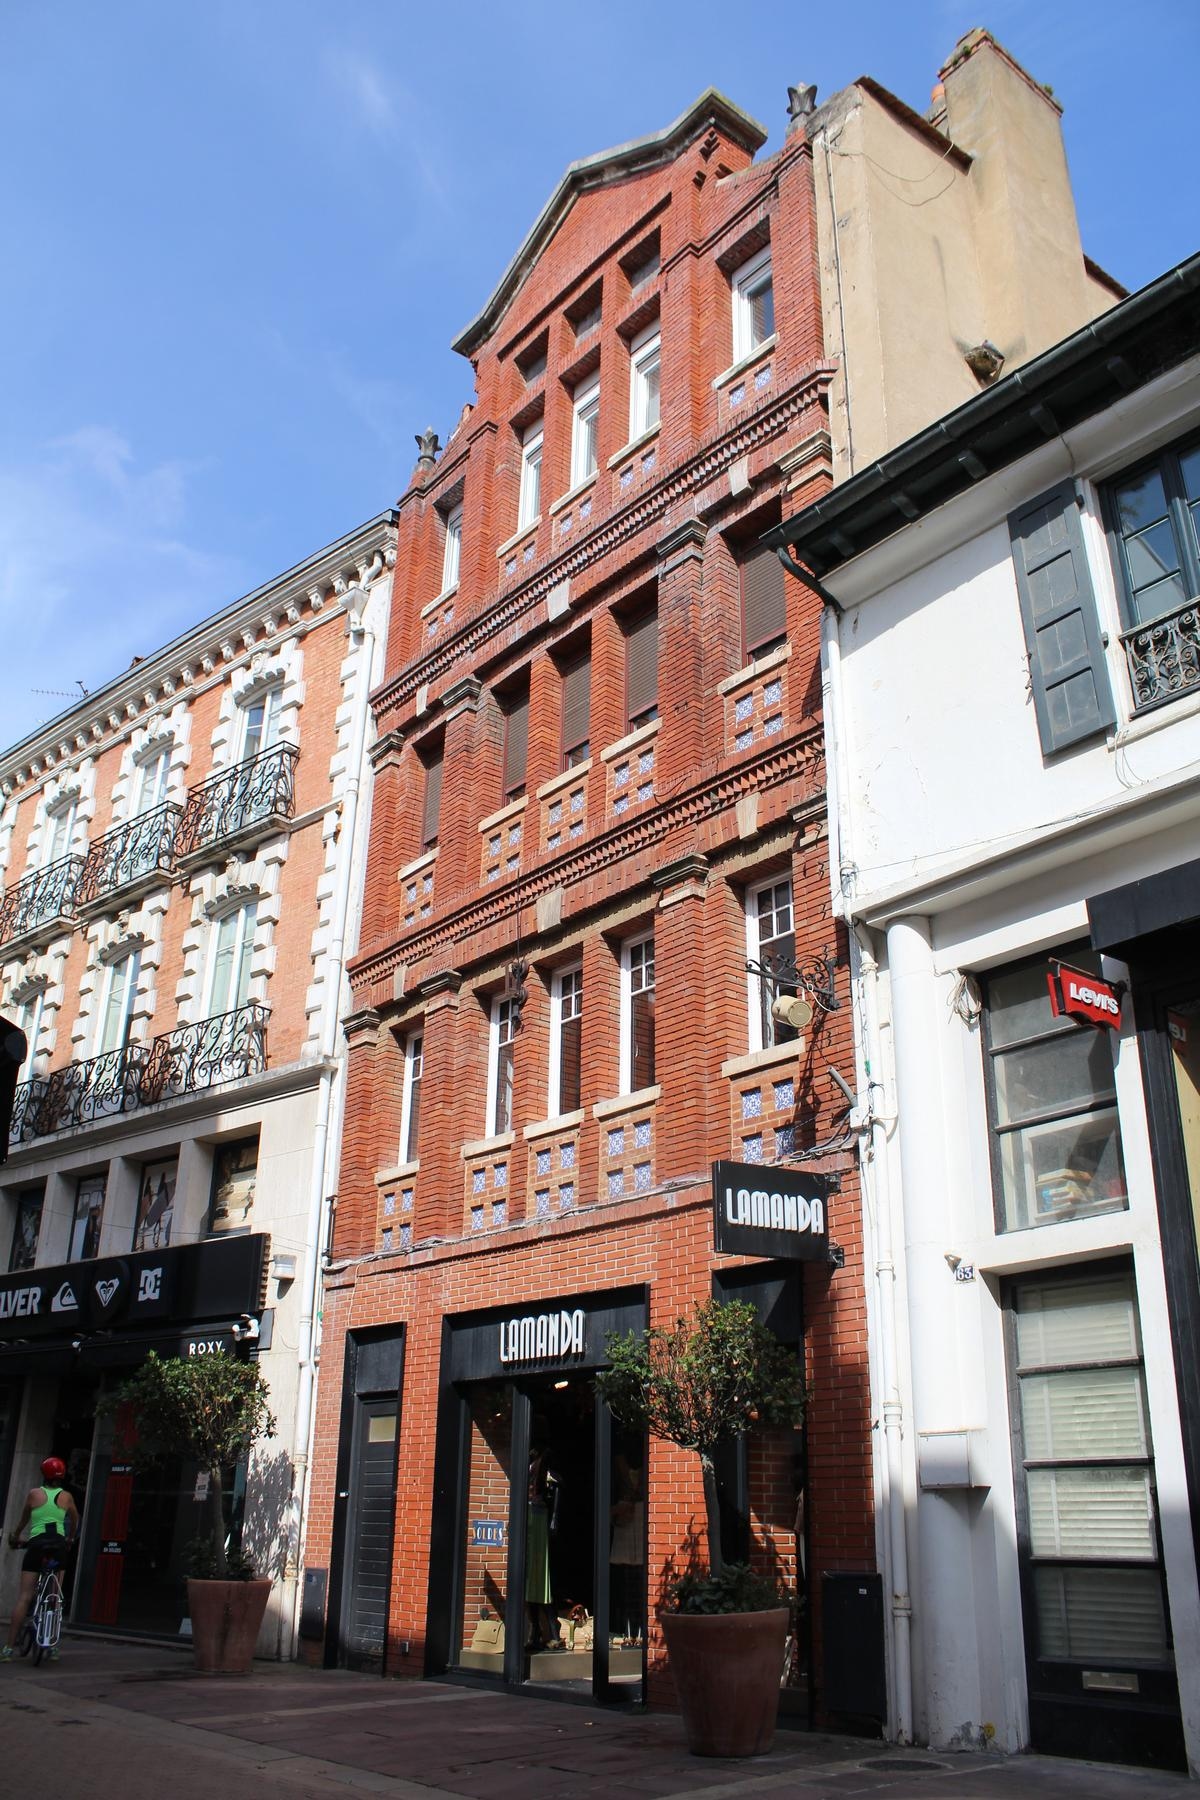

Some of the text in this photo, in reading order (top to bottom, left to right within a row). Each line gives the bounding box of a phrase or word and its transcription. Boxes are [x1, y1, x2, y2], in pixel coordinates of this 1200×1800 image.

[725, 1187, 824, 1234] LAMANDA
[957, 1267, 972, 1280] 63
[189, 1340, 223, 1355] ROXY
[500, 1309, 585, 1362] LAMANDA
